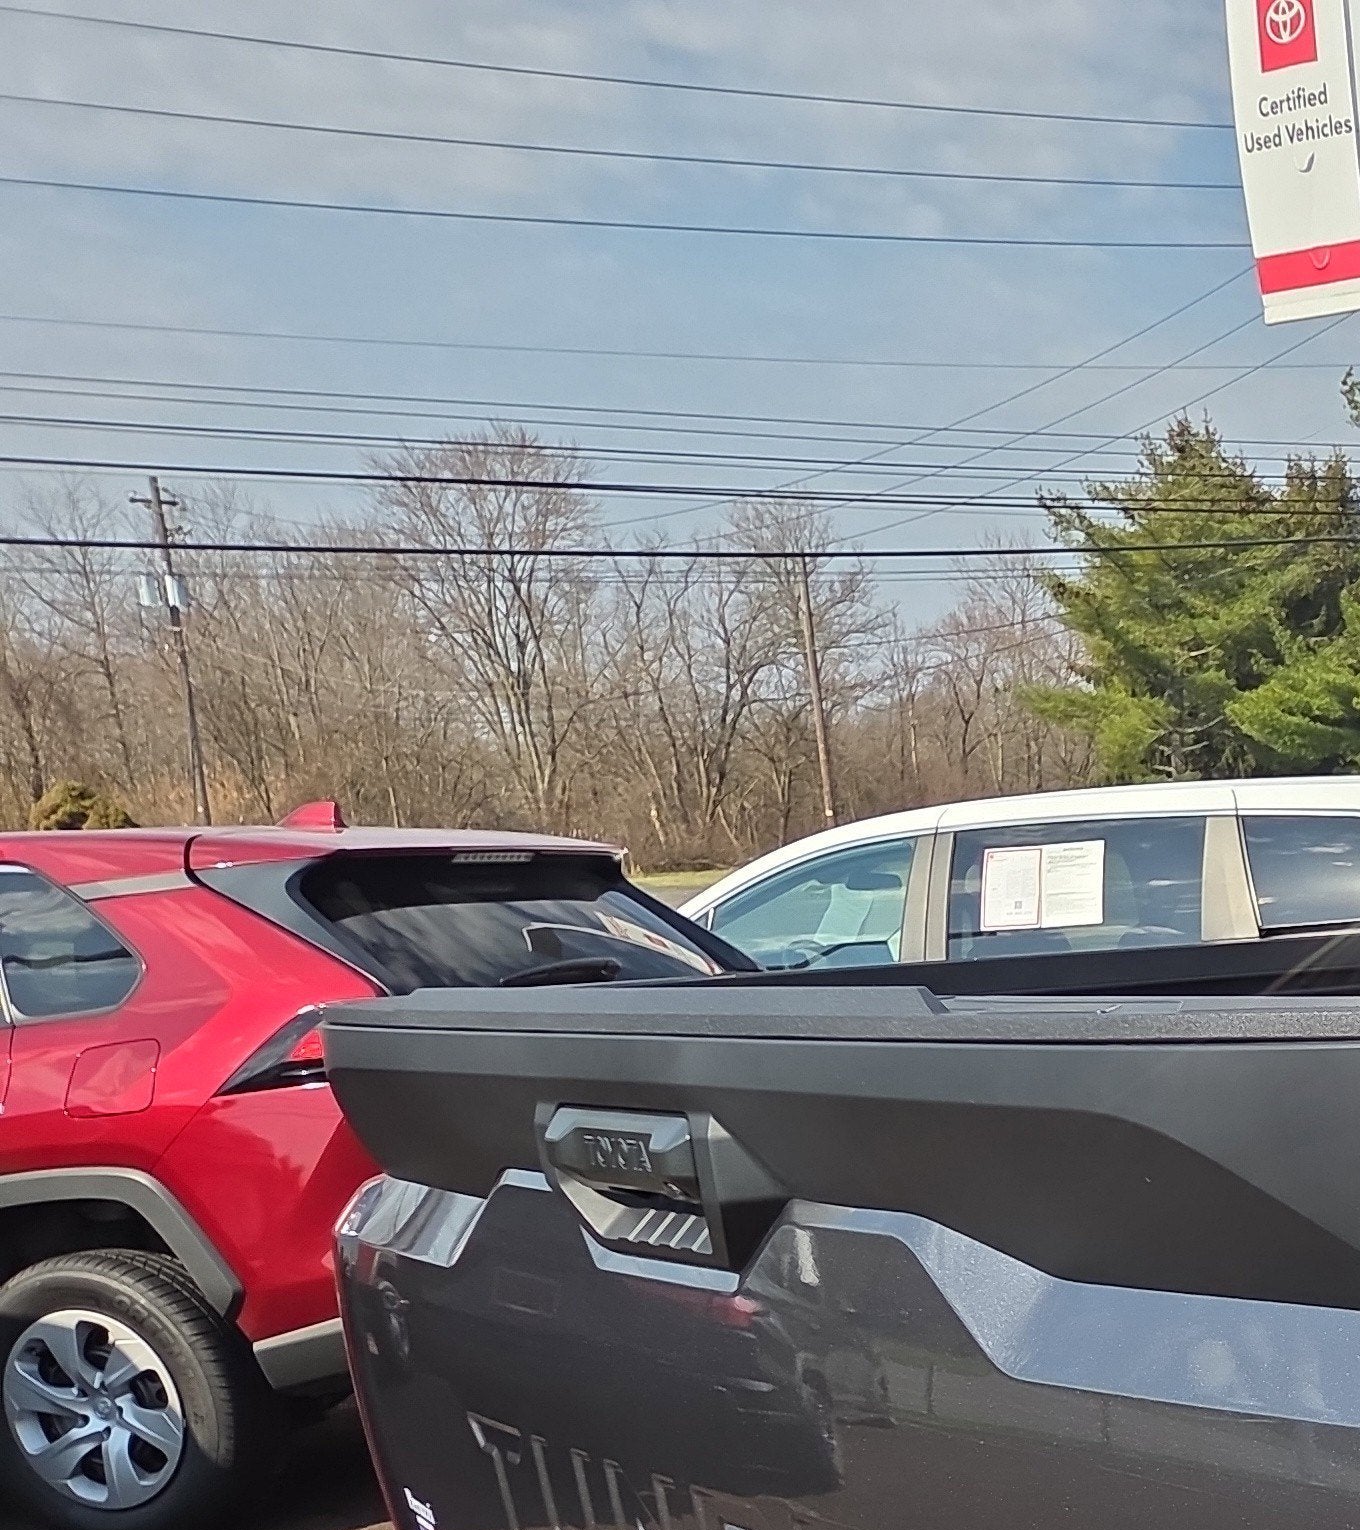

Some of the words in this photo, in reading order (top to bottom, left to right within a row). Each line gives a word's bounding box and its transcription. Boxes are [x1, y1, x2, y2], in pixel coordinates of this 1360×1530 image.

[1258, 82, 1328, 118] Certified
[1243, 125, 1283, 154] Used
[1285, 114, 1353, 145] Vehicles
